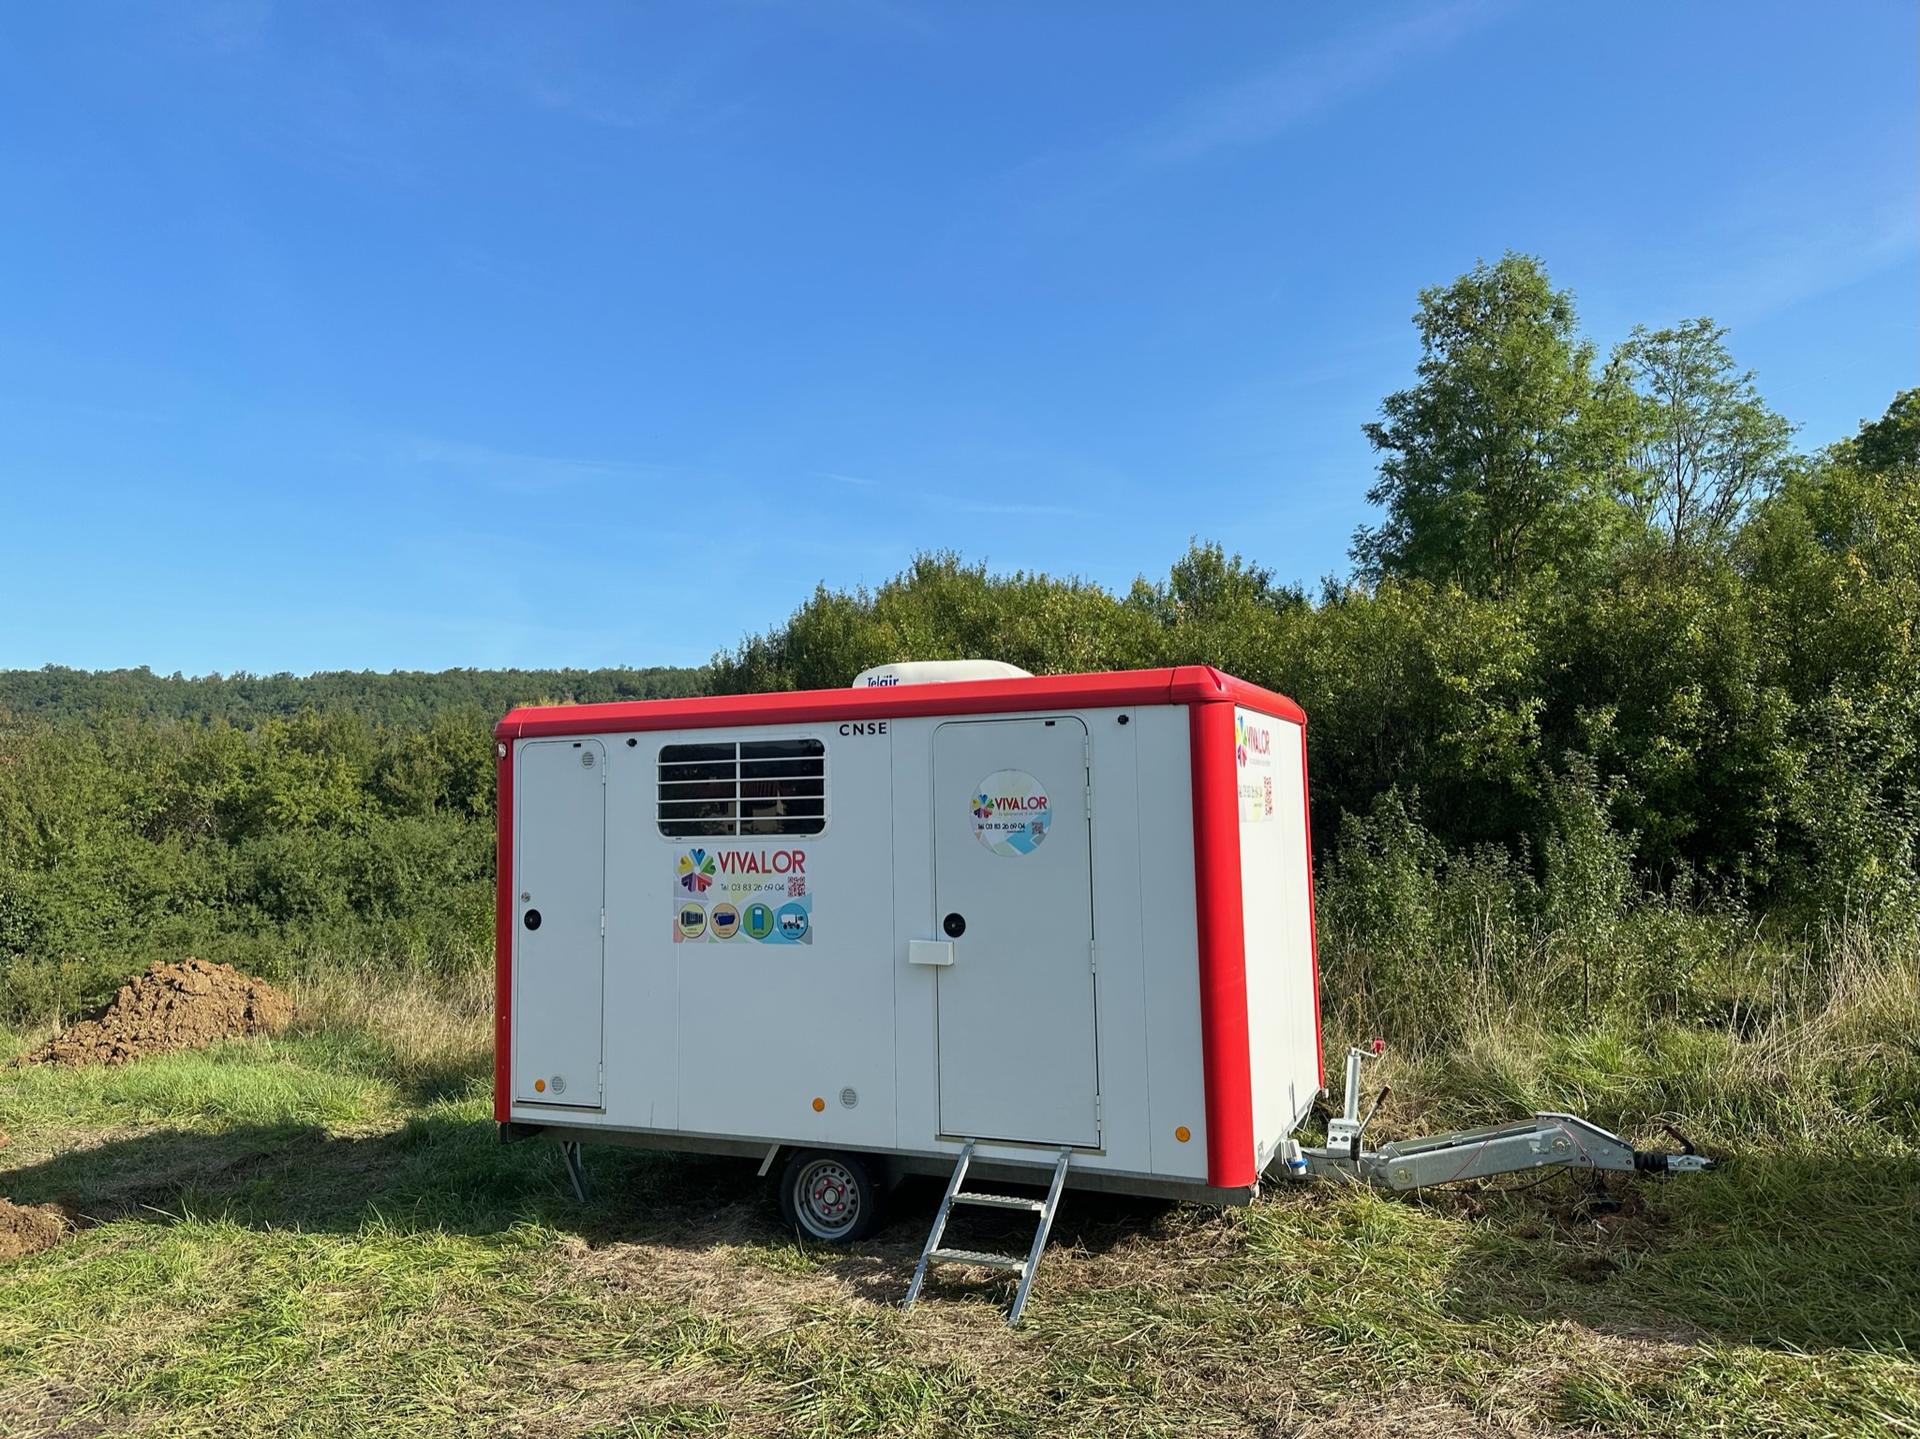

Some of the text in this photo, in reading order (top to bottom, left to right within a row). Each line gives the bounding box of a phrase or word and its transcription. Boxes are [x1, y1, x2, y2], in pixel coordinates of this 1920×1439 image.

[839, 722, 887, 736] CNSE
[1247, 726, 1270, 756] VIVALOR
[995, 796, 1048, 811] VIVALOR
[717, 850, 806, 875] VIVALOR
[731, 883, 741, 891] 03
[742, 883, 752, 891] 83
[753, 883, 763, 891] 26
[764, 883, 774, 891] 69
[774, 883, 785, 891] 04
